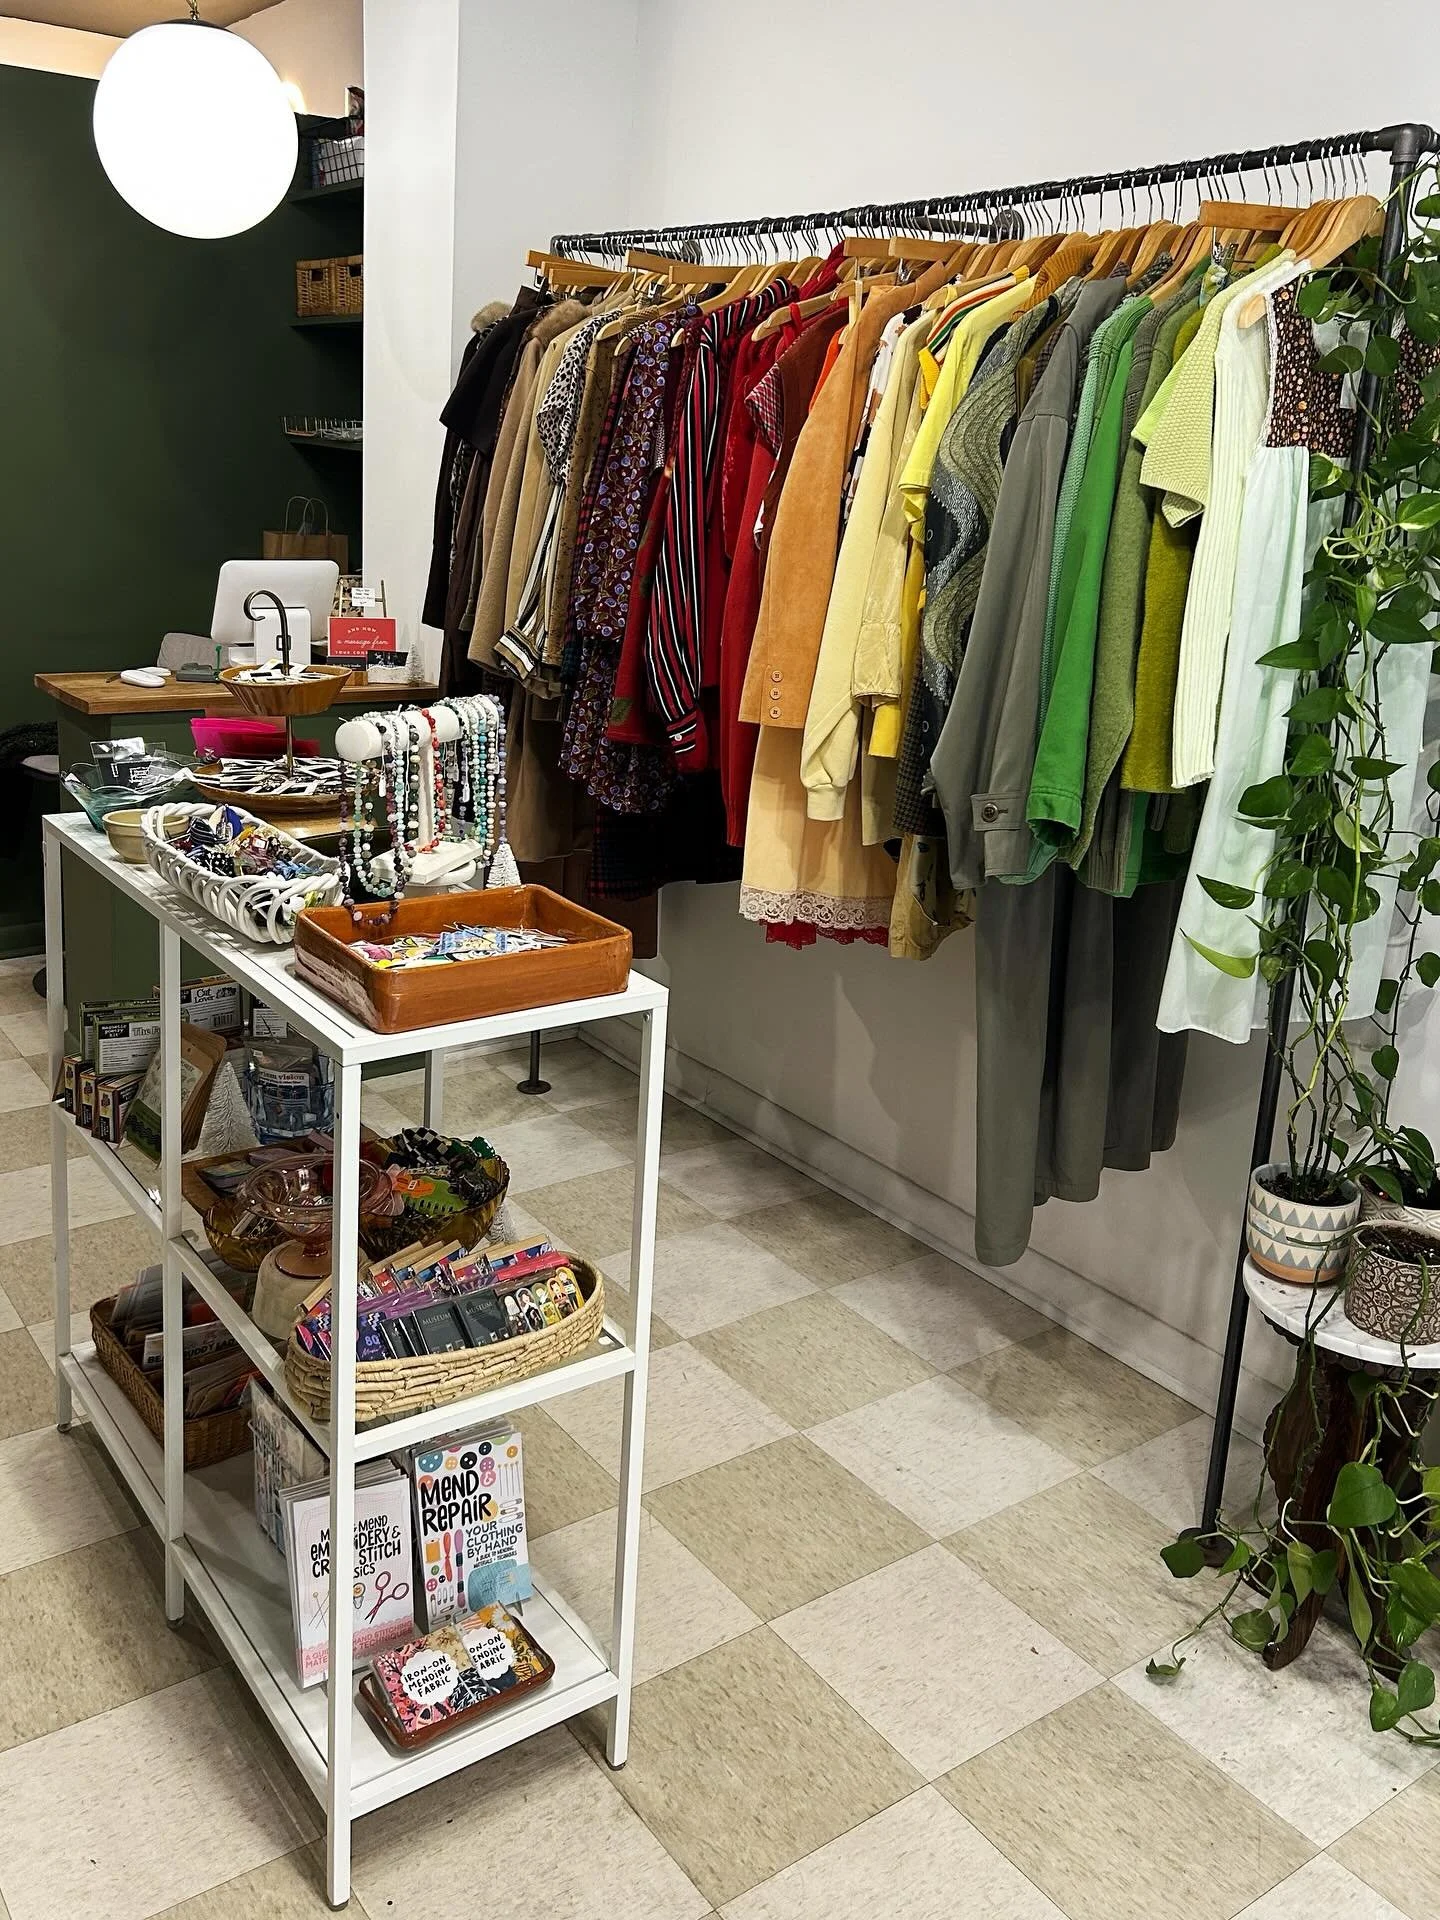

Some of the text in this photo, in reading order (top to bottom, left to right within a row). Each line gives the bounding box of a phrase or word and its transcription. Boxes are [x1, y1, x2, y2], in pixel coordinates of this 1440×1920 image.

[344, 640, 370, 648] message
[371, 636, 388, 648] from
[466, 1521, 497, 1538] YOUR
[466, 1523, 523, 1548] CLOTHING
[468, 1535, 518, 1558] BY HAND
